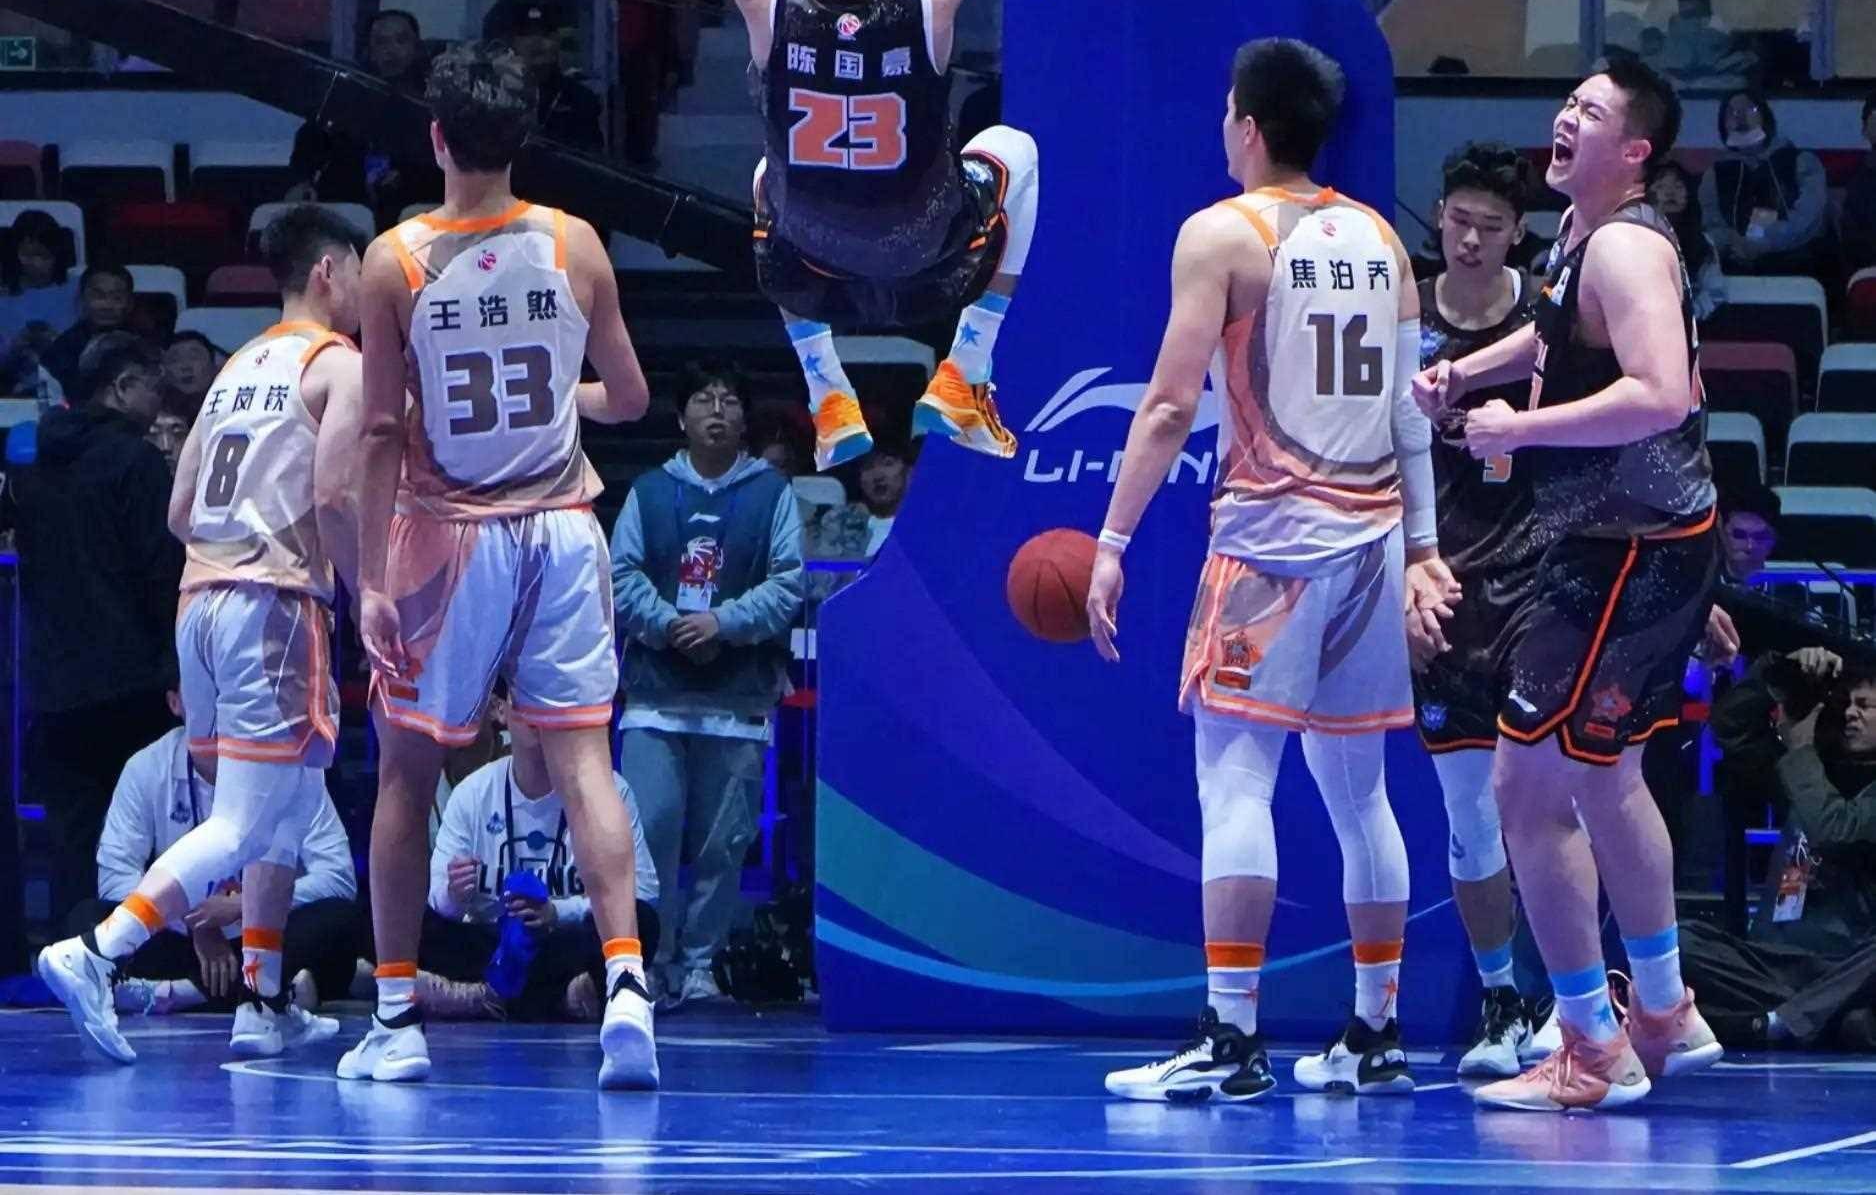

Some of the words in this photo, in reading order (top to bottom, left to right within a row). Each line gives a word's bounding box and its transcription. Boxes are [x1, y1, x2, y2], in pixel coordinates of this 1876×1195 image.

[788, 87, 908, 170] 23
[1290, 258, 1390, 291] 焦泊乔
[429, 289, 558, 331] 王浩然
[1306, 313, 1384, 397] 16
[443, 344, 556, 436] 33
[204, 433, 251, 508] 8
[1024, 449, 1213, 485] LI-N
[479, 862, 586, 897] LING
